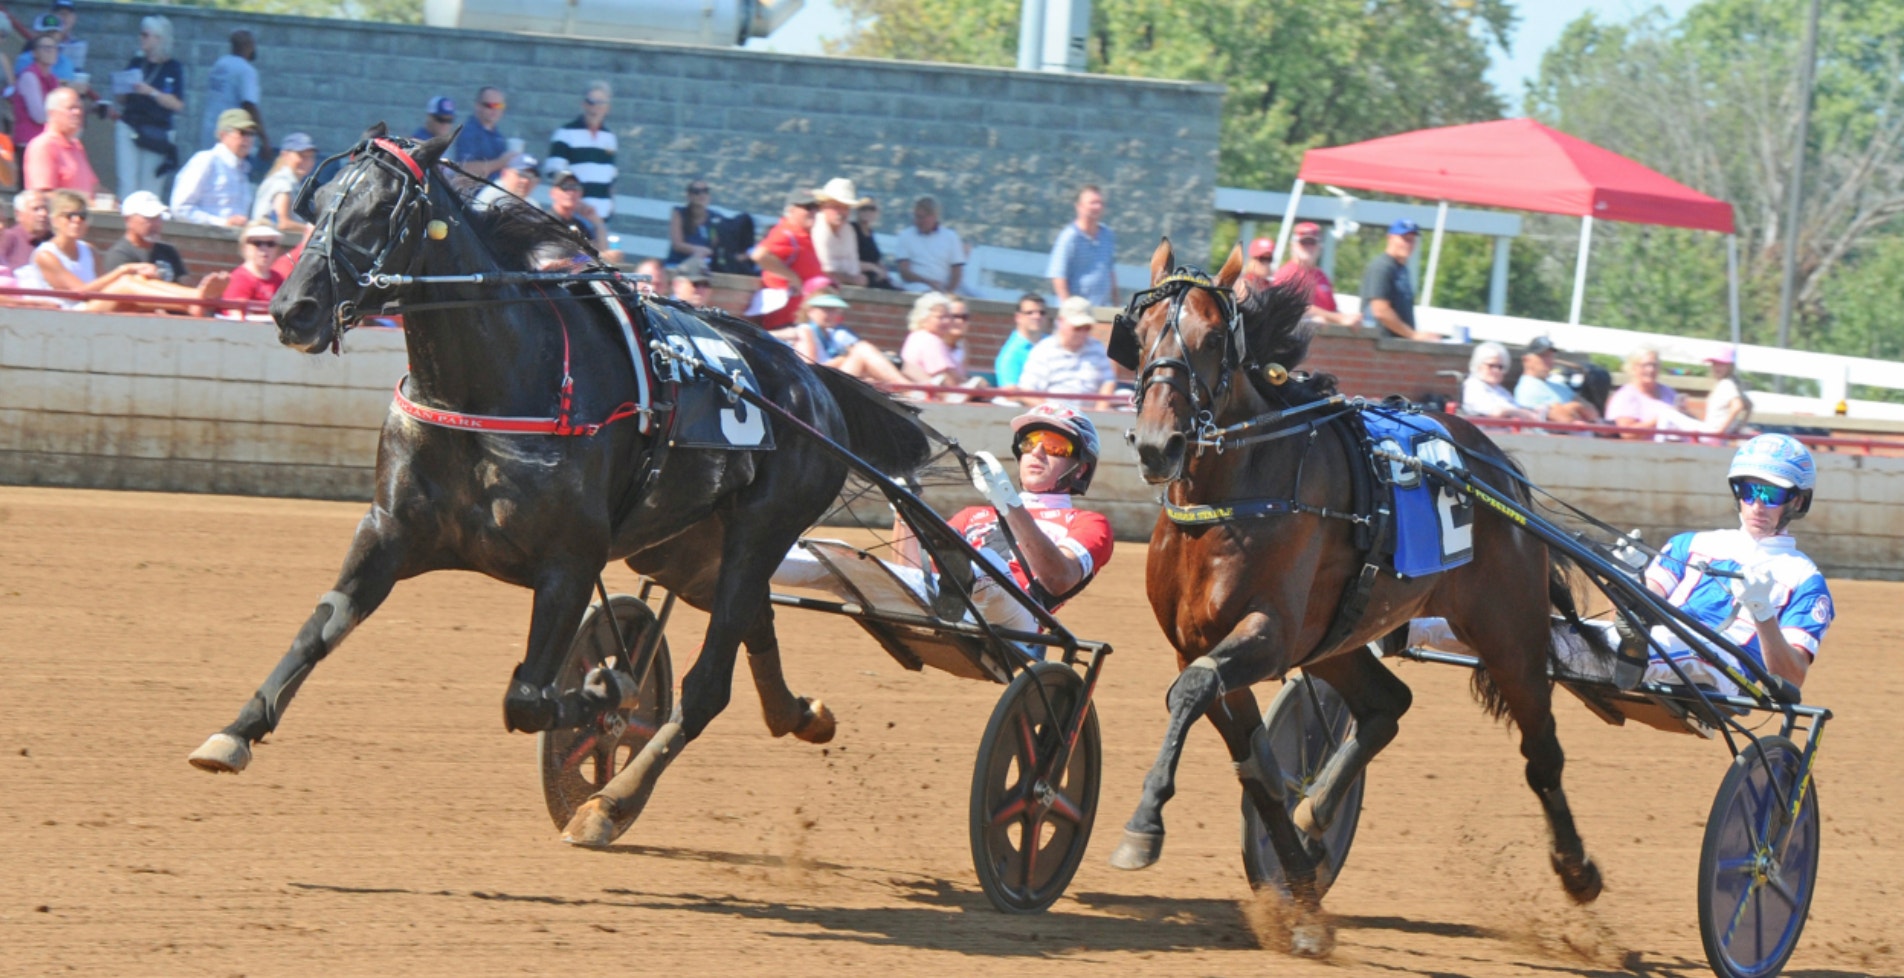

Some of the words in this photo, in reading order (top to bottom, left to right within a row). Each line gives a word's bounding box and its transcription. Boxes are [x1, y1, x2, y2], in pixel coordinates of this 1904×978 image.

[438, 414, 483, 428] PARK
[690, 336, 766, 446] 5
[1416, 438, 1473, 556] 2
